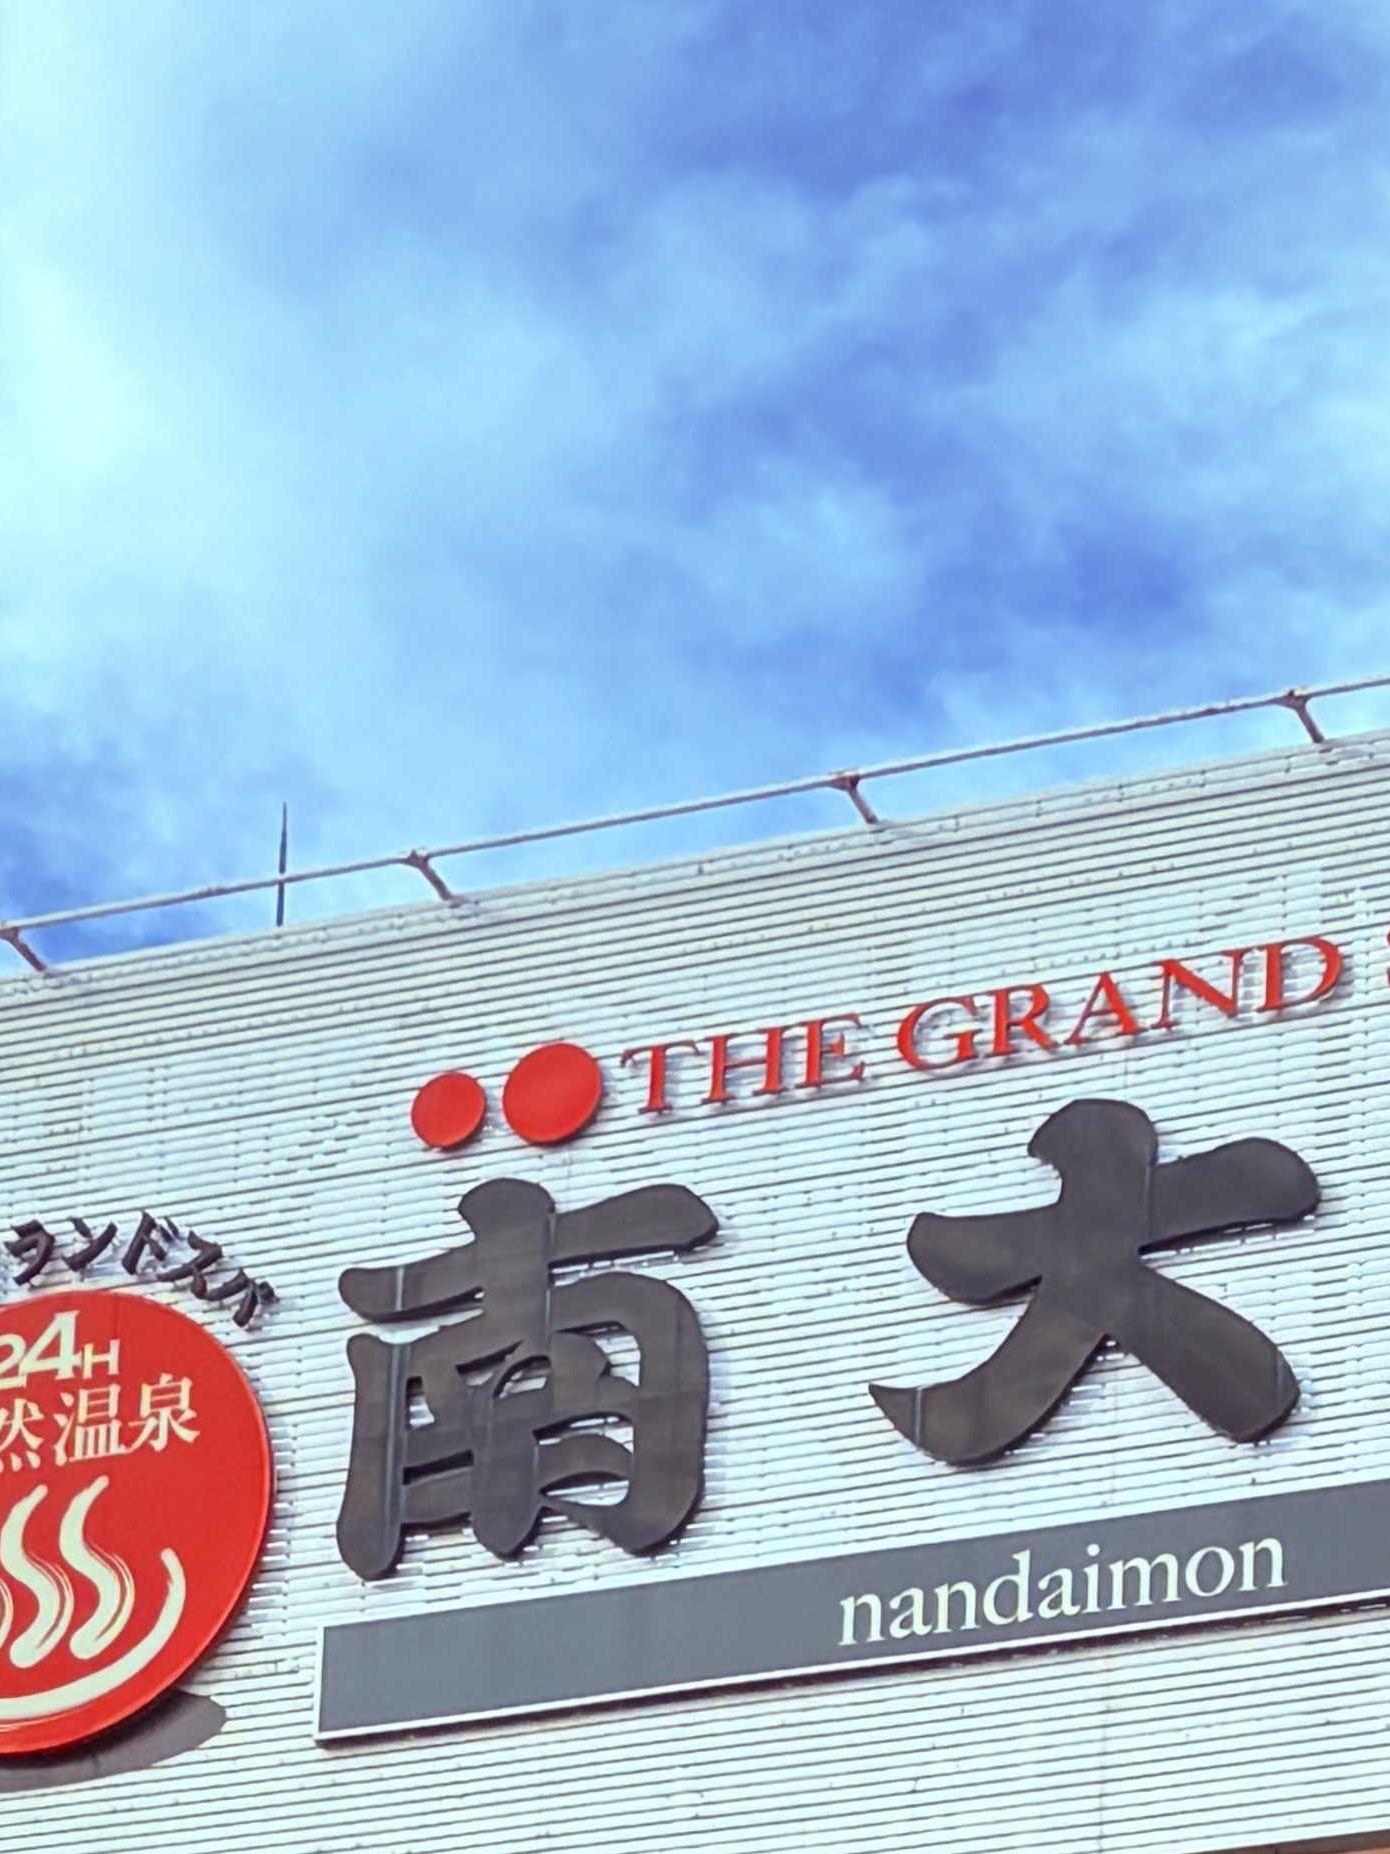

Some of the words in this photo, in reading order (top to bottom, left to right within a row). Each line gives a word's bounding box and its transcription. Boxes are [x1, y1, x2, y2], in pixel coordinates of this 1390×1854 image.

[619, 1014, 867, 1114] THE
[897, 936, 1345, 1073] GRAND
[838, 1532, 1287, 1646] nandaimon
